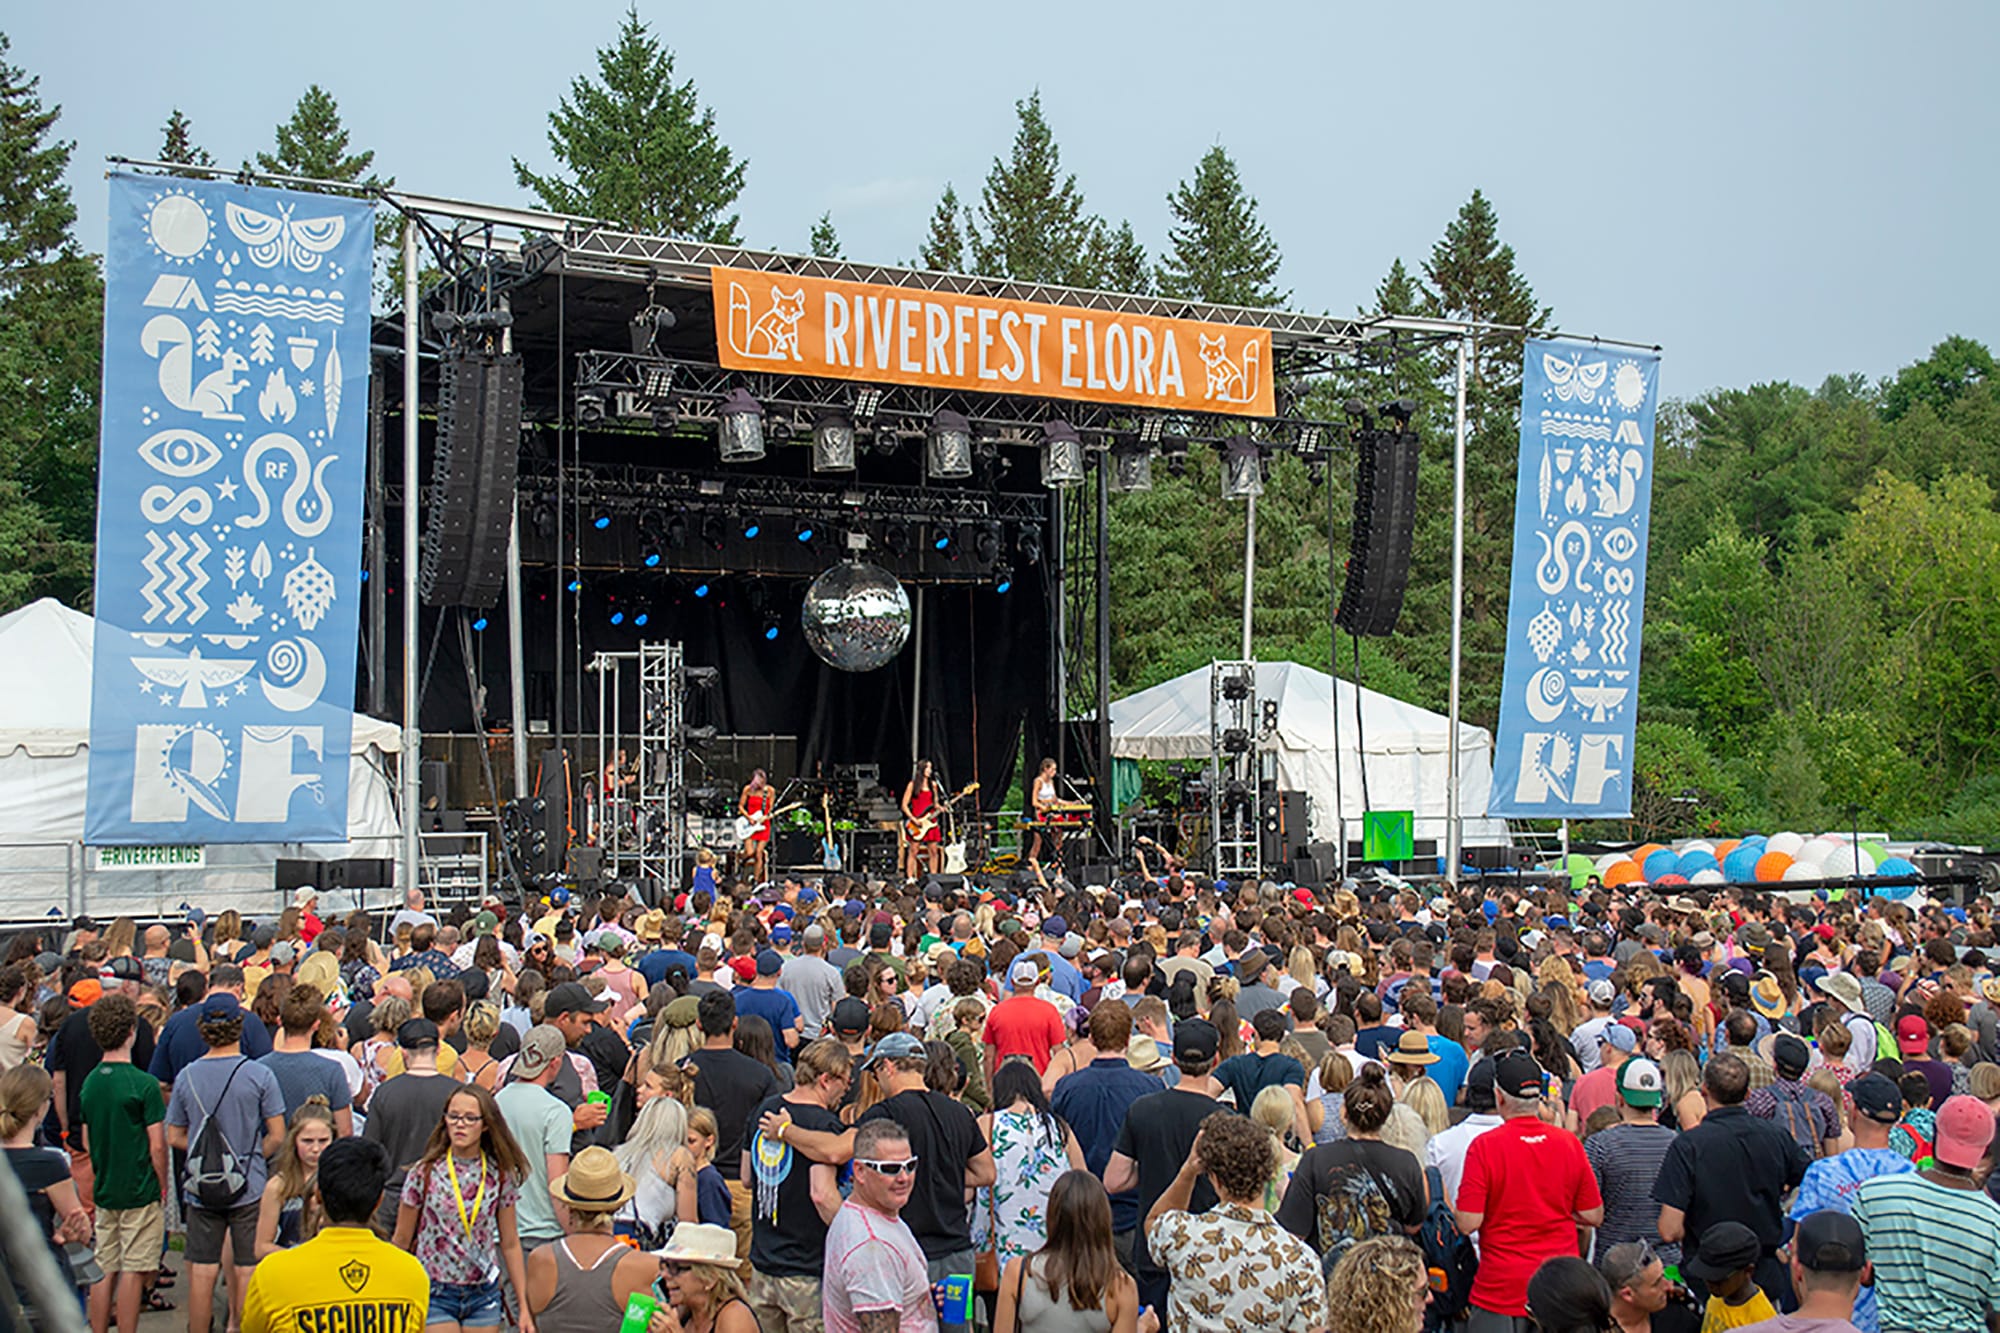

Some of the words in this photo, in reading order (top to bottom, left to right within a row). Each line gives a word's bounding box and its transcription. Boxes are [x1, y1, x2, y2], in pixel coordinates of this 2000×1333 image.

[824, 291, 1047, 384] RIVERFEST
[1061, 318, 1185, 397] ELORA
[265, 461, 289, 478] RF
[130, 721, 325, 823] RF
[1514, 730, 1624, 805] RF
[101, 845, 201, 865] #RIVERFRIENDS
[297, 1303, 412, 1333] SECURITY
